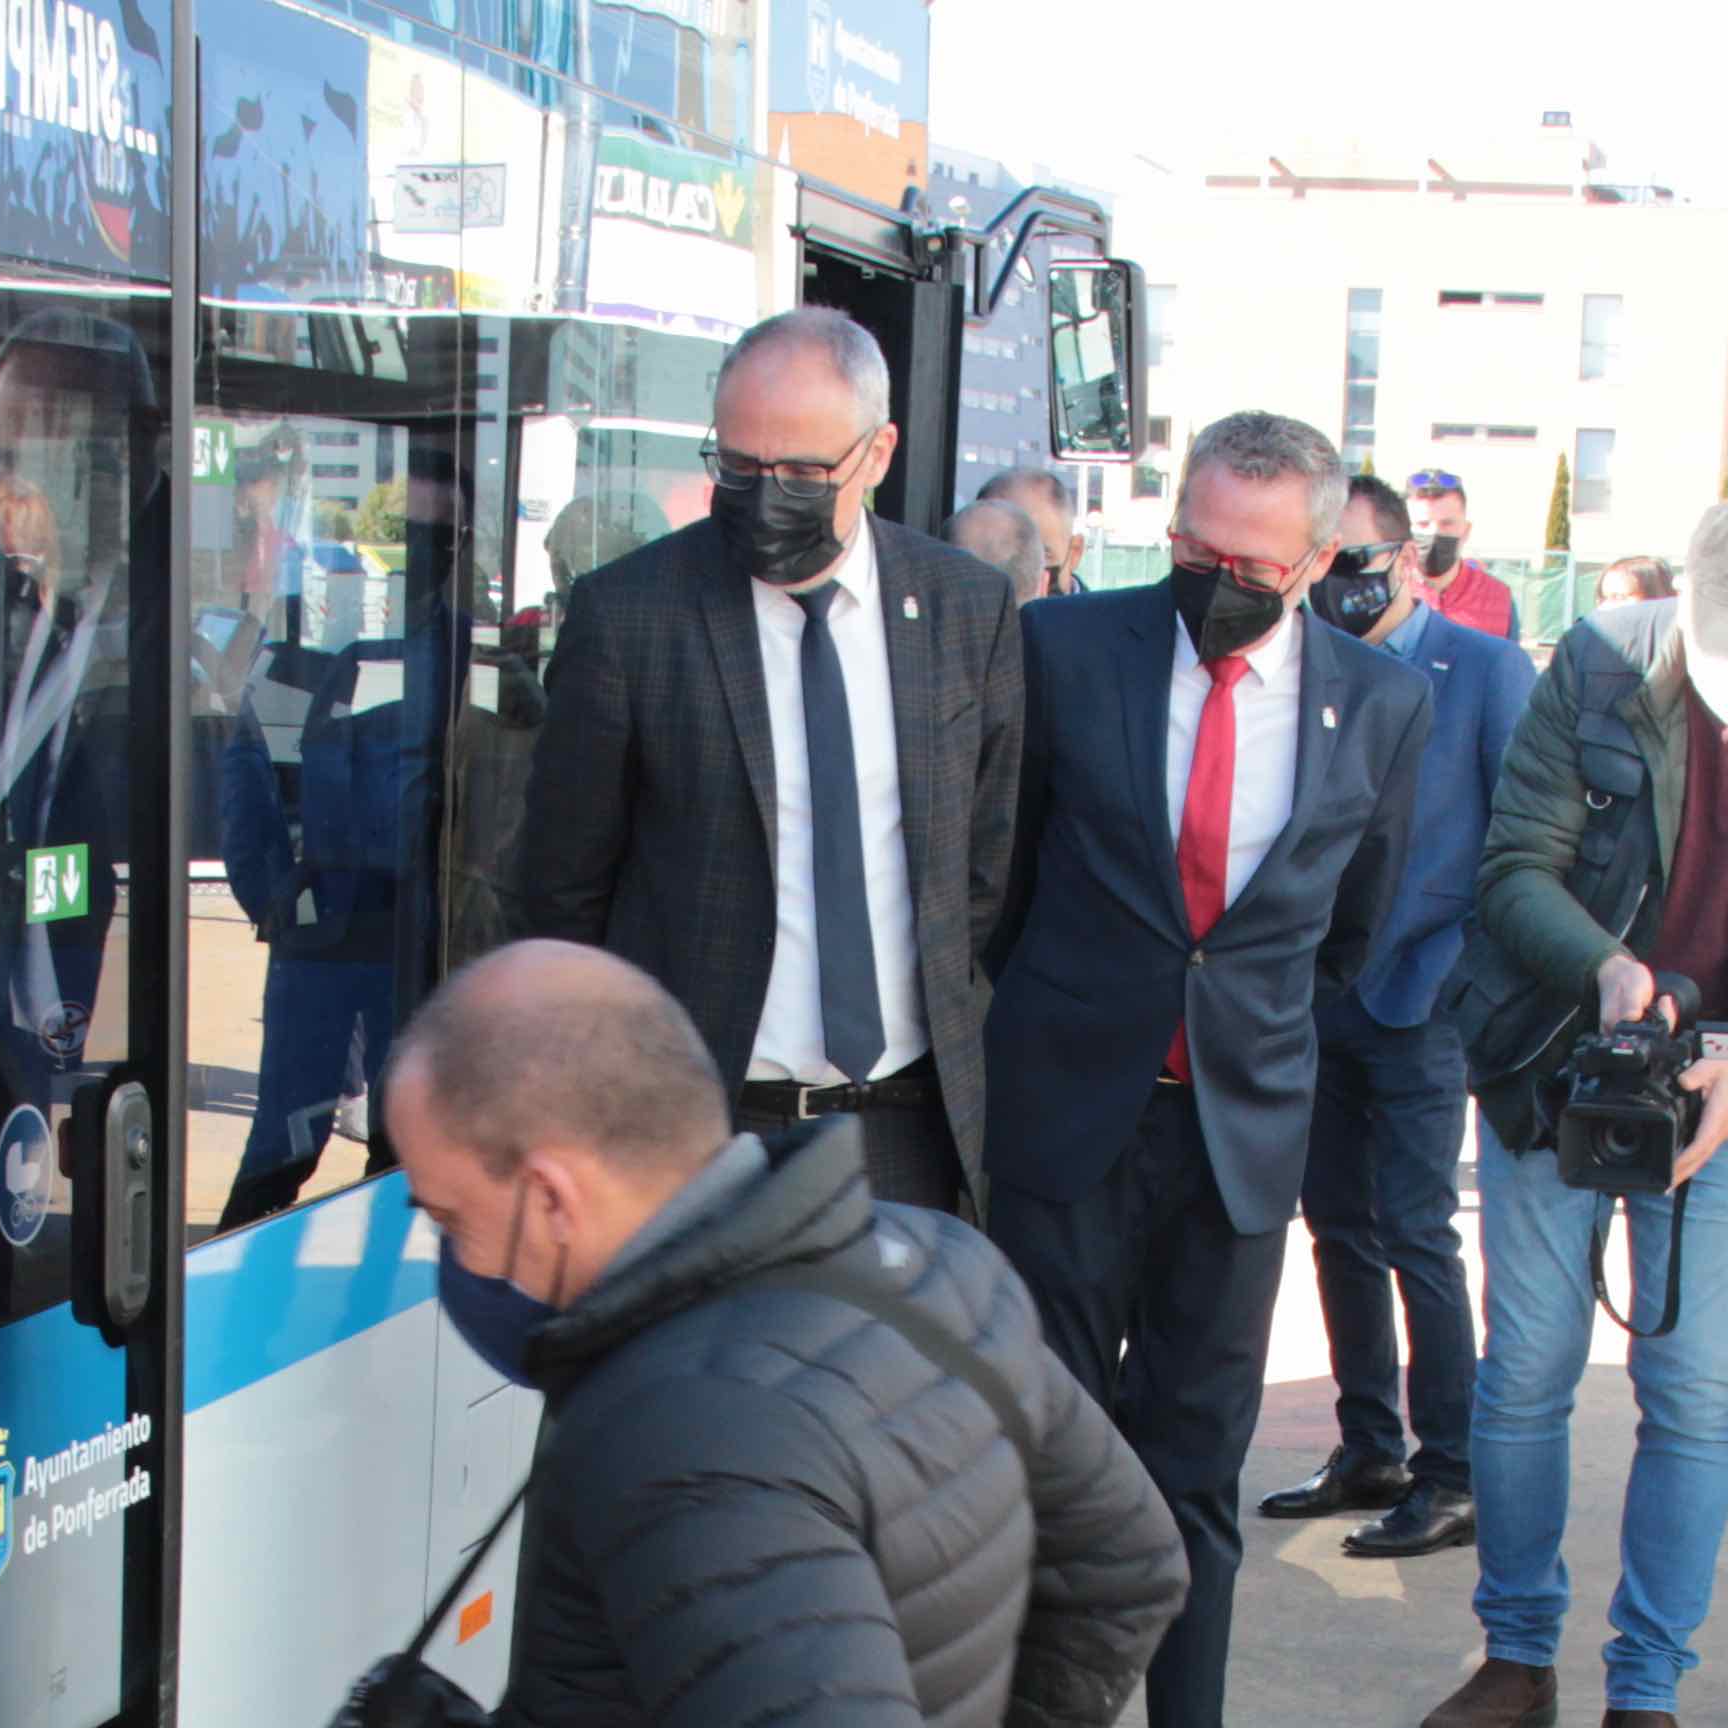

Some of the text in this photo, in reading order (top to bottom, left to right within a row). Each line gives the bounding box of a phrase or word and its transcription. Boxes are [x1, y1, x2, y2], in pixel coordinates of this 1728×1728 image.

[23, 1411, 152, 1499] Ayuntamiento
[23, 1464, 152, 1555] de Ponferrada
